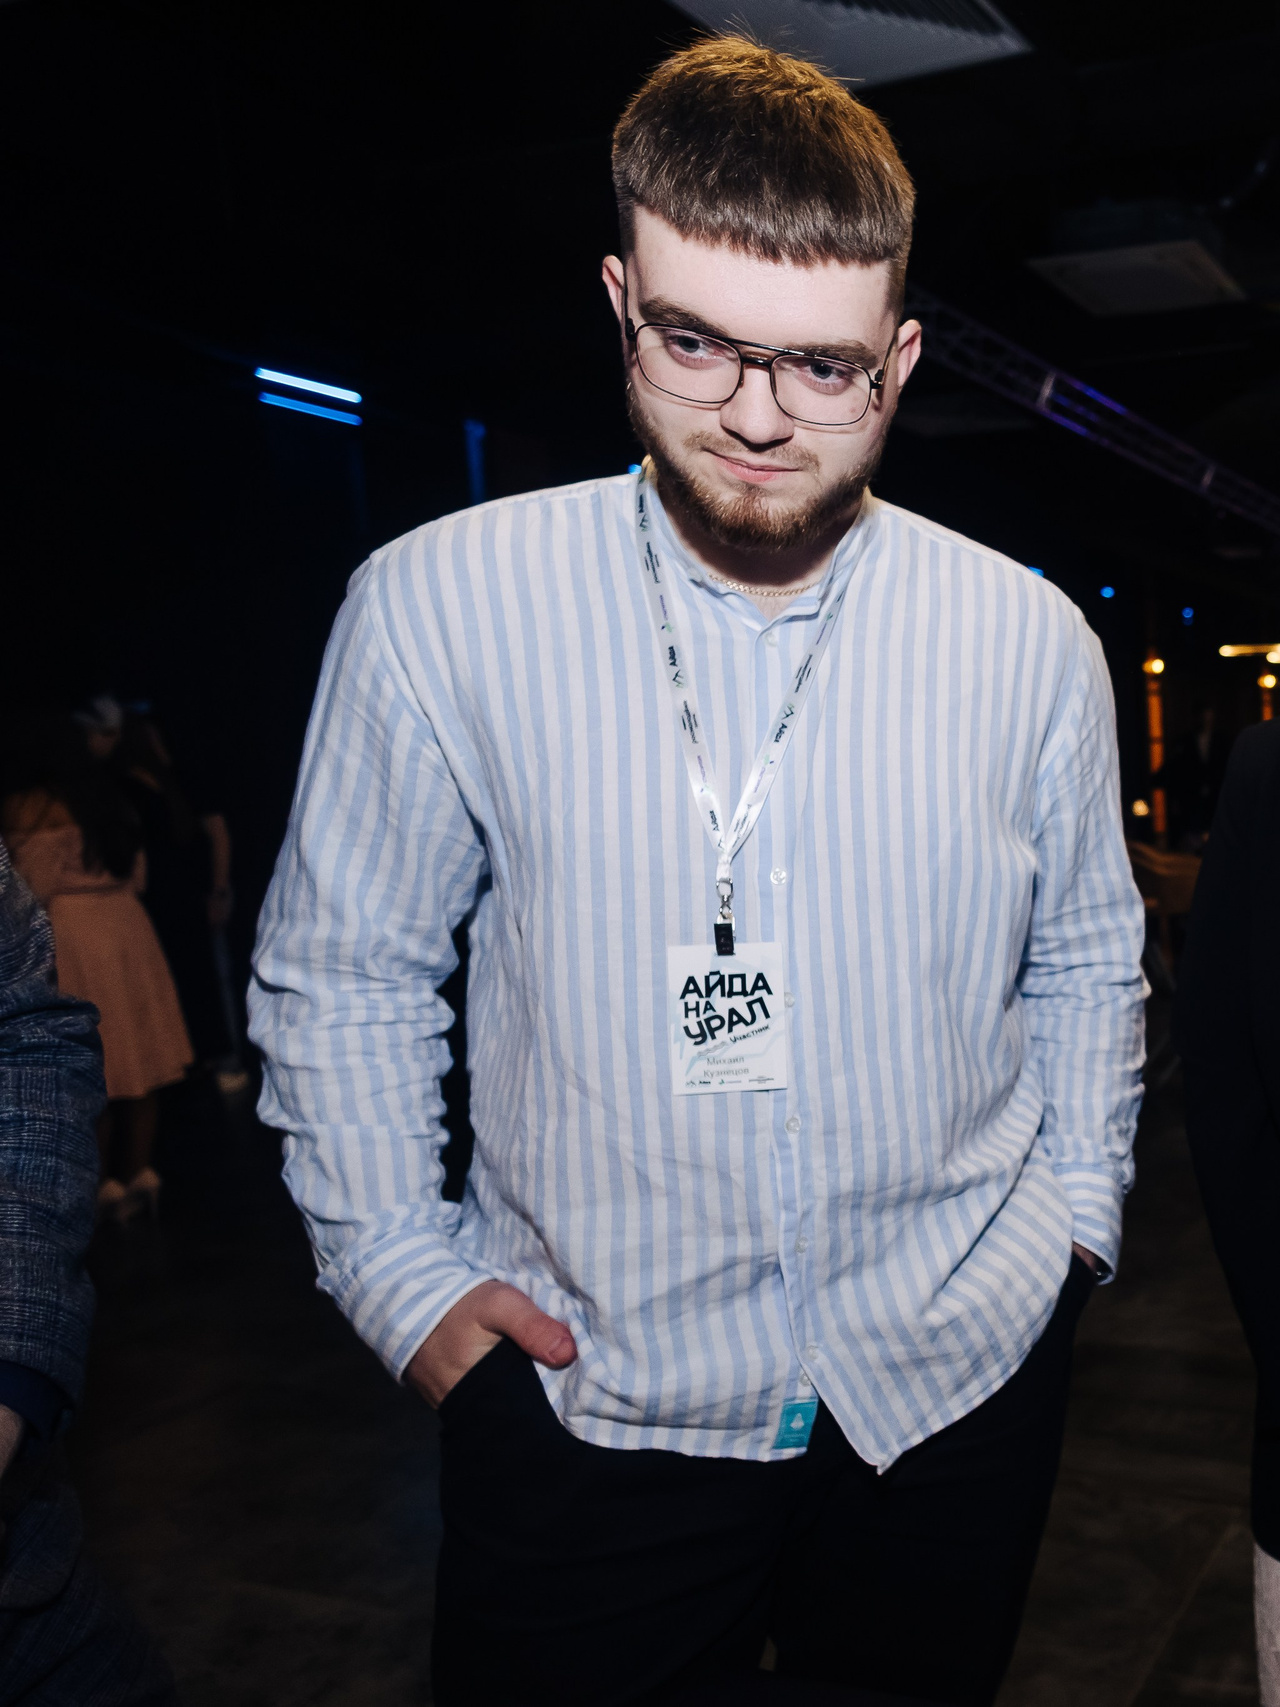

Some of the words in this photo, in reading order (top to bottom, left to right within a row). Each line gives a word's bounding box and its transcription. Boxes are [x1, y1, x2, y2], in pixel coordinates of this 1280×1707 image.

[679, 970, 773, 1000] АЙДА
[683, 996, 771, 1046] УРАЛ
[684, 1000, 717, 1019] НА
